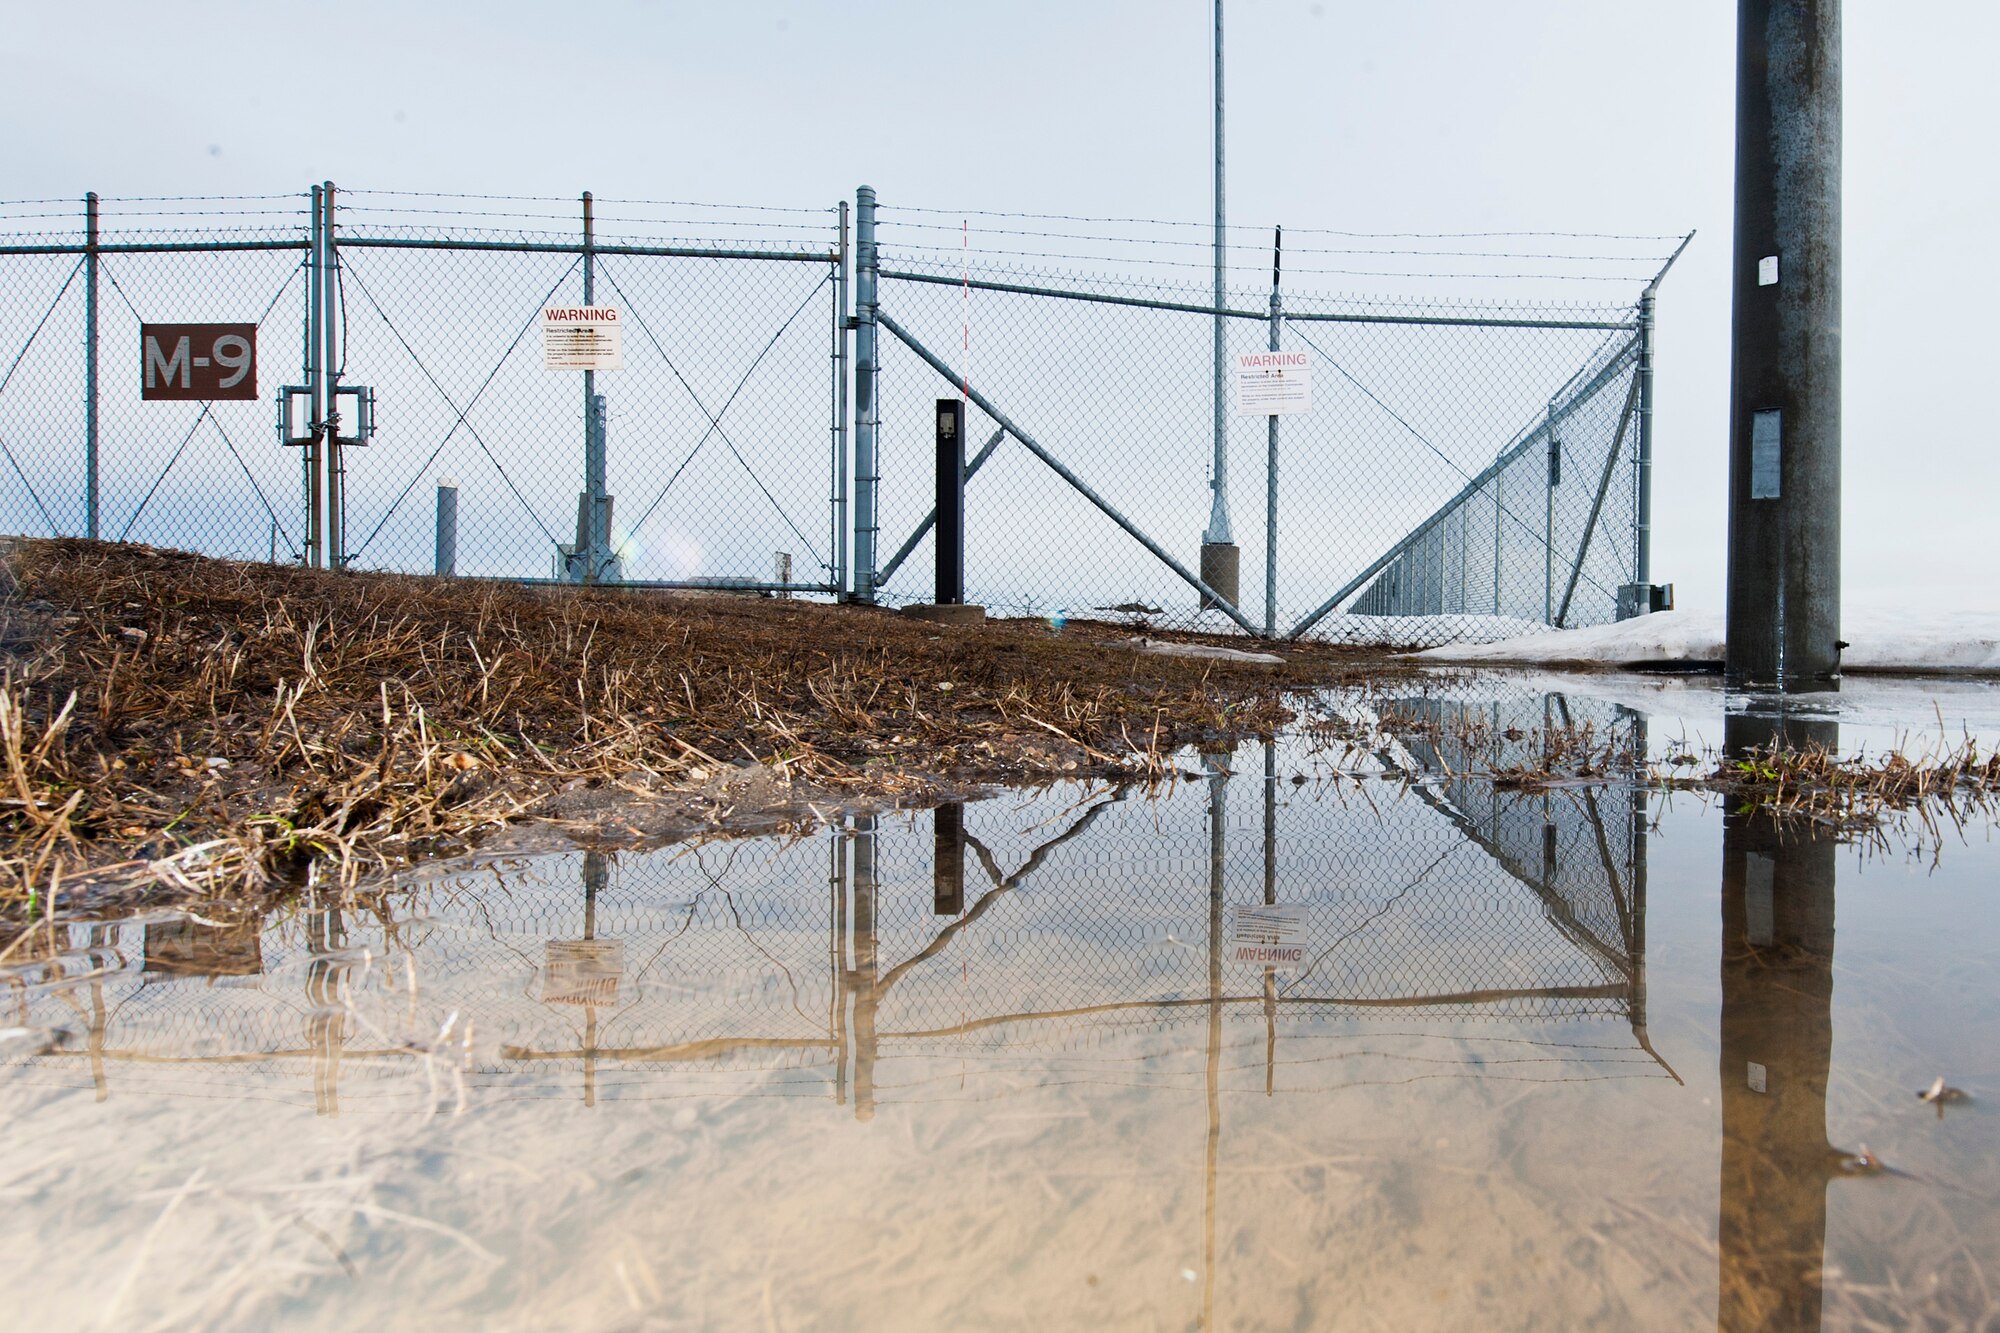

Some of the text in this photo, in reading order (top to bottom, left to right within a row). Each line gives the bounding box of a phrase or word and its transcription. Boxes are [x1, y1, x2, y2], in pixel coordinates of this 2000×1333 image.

[545, 309, 616, 321] WARNING
[145, 334, 252, 388] M-9
[1240, 353, 1306, 367] WARNING
